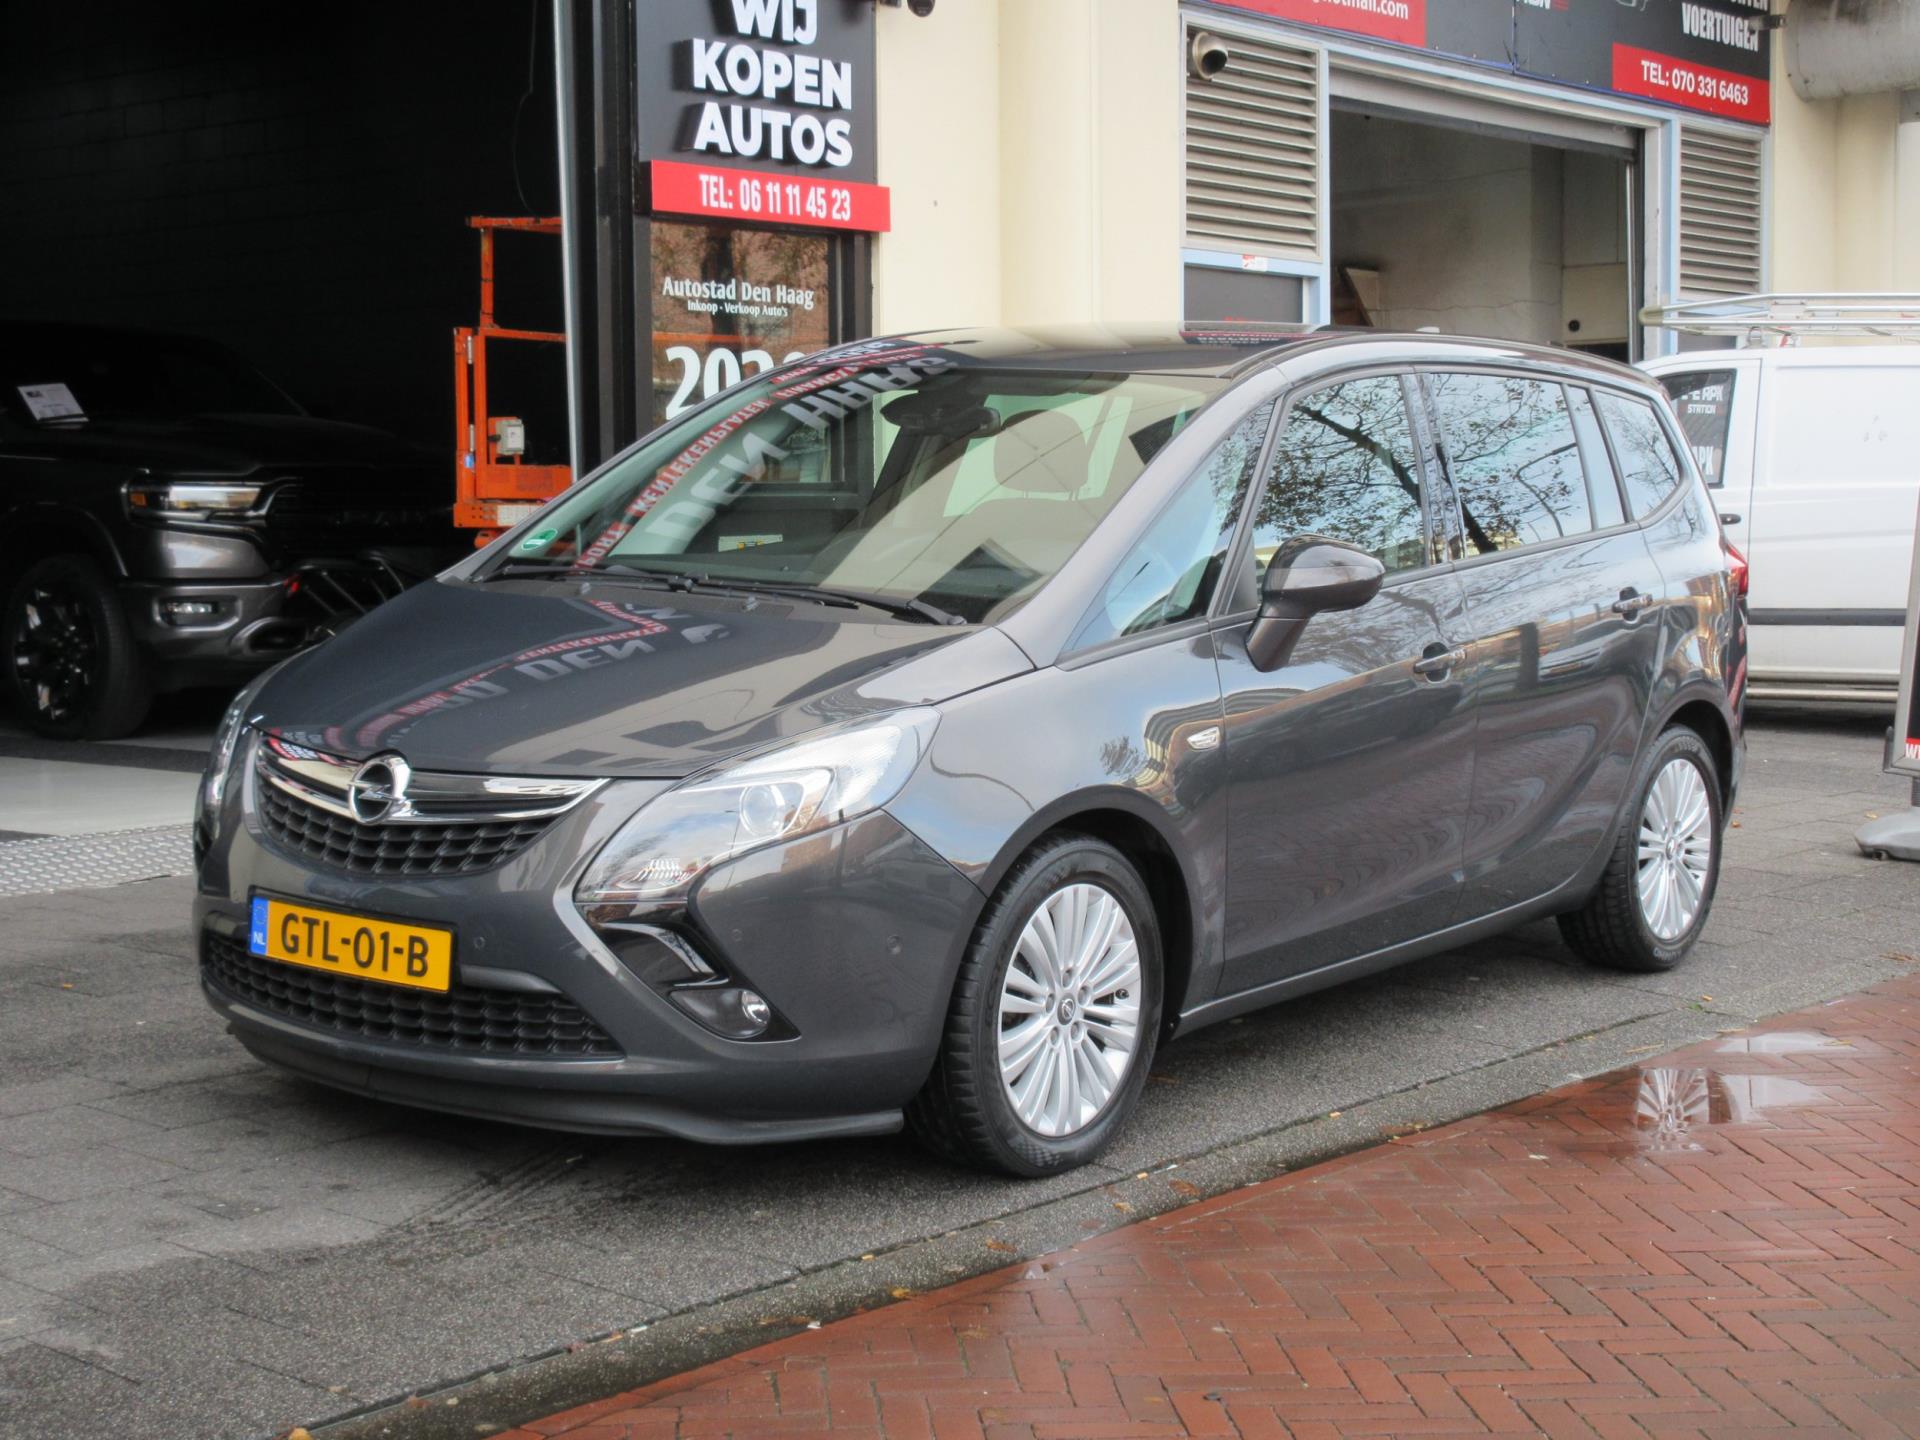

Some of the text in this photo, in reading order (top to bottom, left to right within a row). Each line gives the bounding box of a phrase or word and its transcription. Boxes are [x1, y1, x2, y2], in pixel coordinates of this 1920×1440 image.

[732, 0, 818, 45] WIJ
[692, 38, 852, 110] KOPEN
[1641, 60, 1749, 106] TEL: 070 331 6463
[693, 101, 853, 167] AUTOS
[698, 173, 851, 222] TEL: 06 11 11 45 23
[662, 276, 815, 310] Autostad Den Haag
[687, 300, 718, 316] Inkoop
[724, 302, 761, 317] Verkoop
[762, 305, 788, 317] Auto's
[253, 931, 266, 946] NL
[281, 912, 429, 978] GTL-01-B
